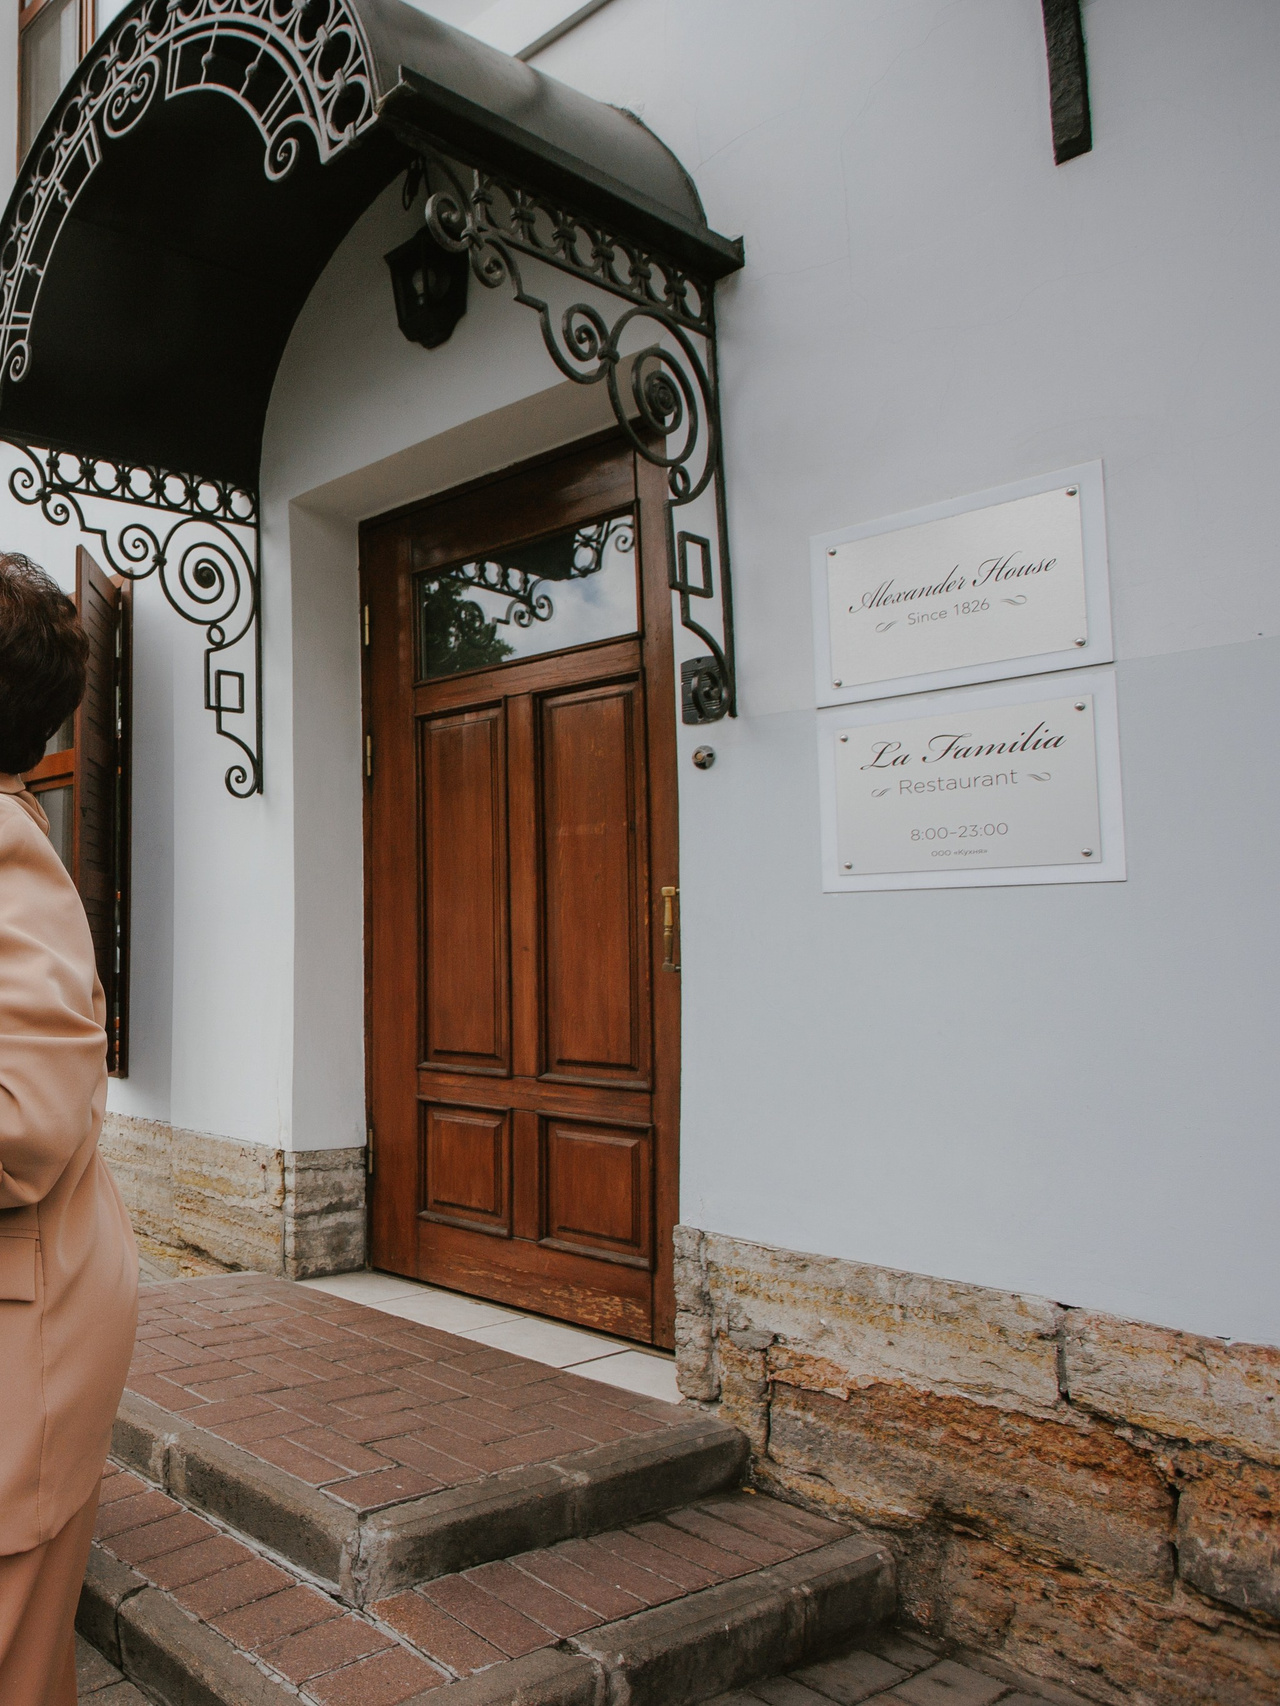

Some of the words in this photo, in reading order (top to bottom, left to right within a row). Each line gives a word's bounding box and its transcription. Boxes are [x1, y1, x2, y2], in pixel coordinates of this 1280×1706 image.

[849, 564, 967, 614] Alexander
[972, 551, 1057, 587] House
[907, 609, 948, 626] Since
[954, 599, 990, 616] 1826
[860, 741, 911, 771] La
[921, 721, 1067, 764] Familia
[898, 769, 1019, 796] Restaurant
[910, 822, 1008, 842] 8:00-23:00
